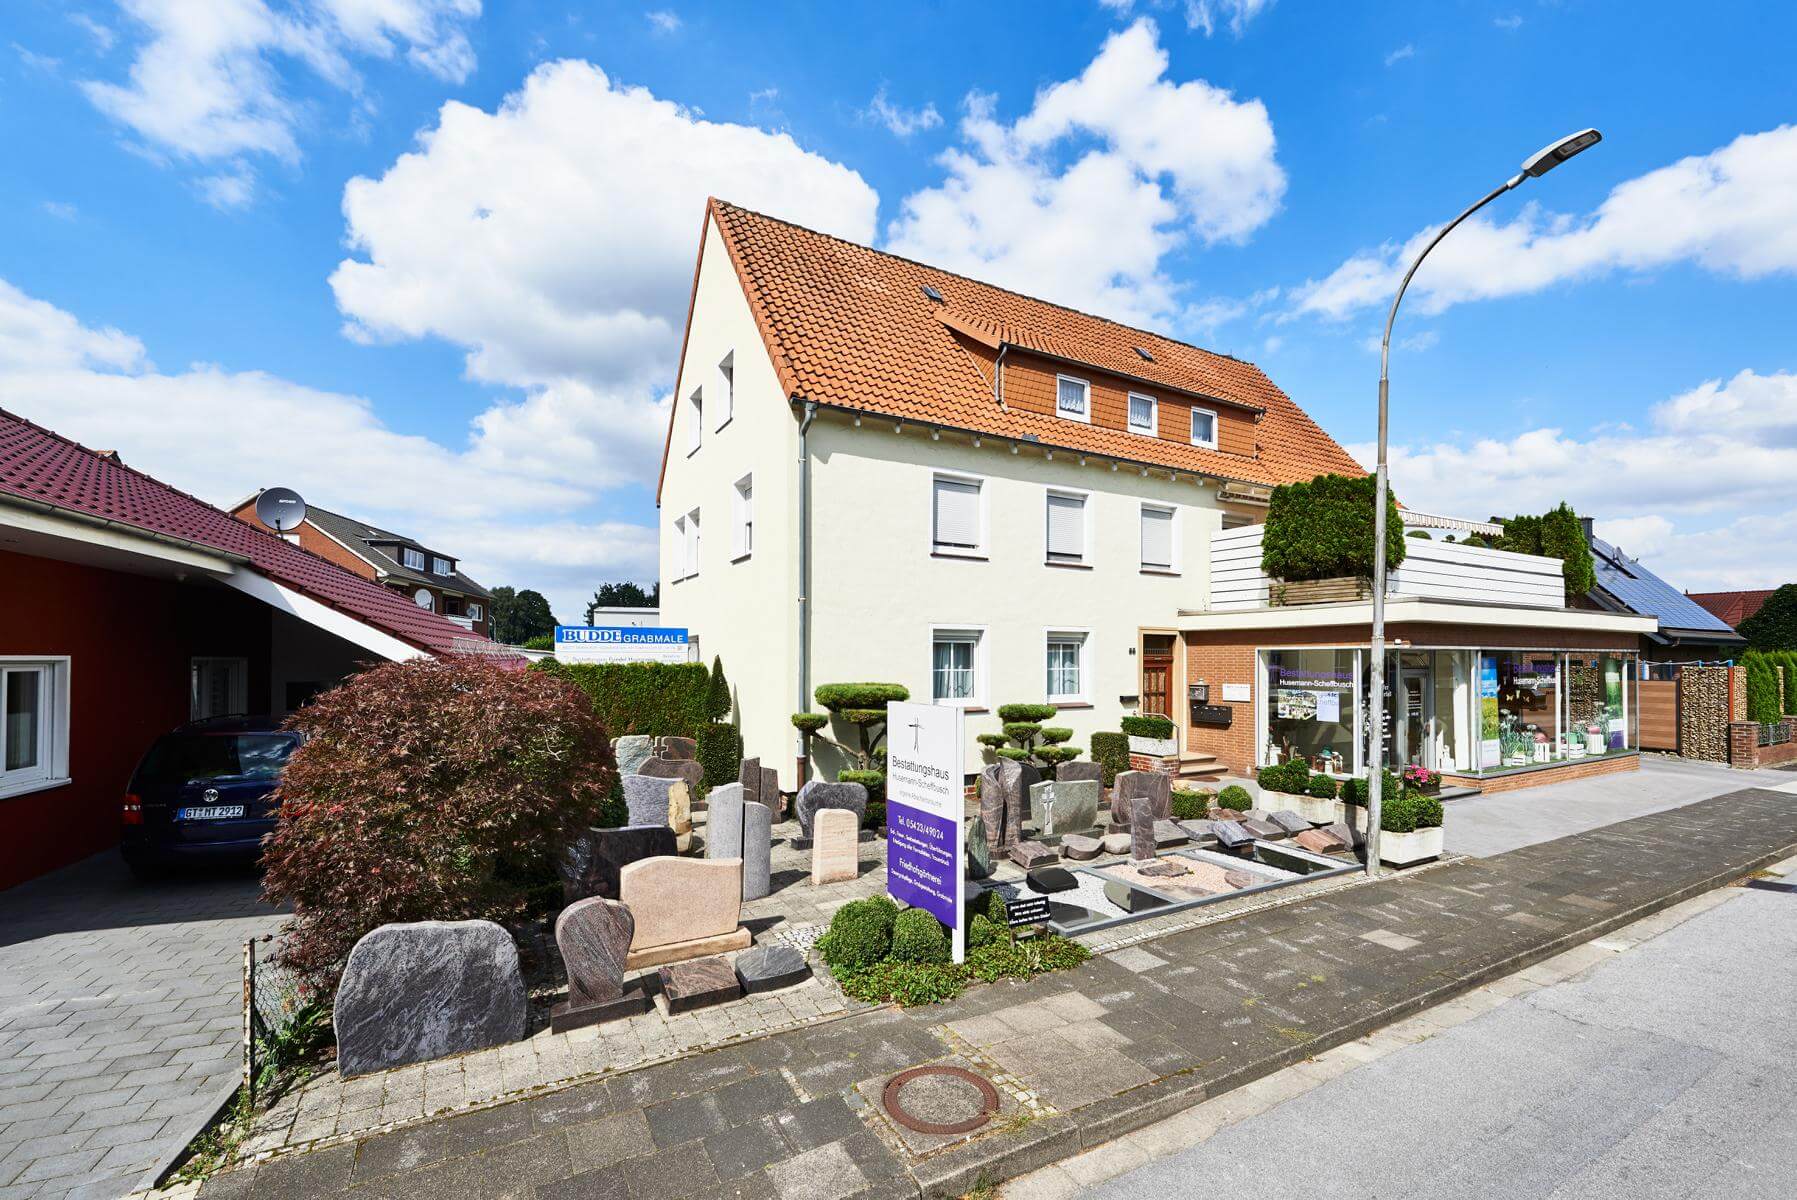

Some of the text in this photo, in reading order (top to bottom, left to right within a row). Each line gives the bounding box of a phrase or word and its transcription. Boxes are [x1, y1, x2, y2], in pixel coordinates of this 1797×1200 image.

[563, 630, 684, 643] BUDDE GRABMALE
[892, 755, 950, 780] Bestattungshaus
[186, 808, 198, 817] GT
[219, 806, 242, 816] 2912
